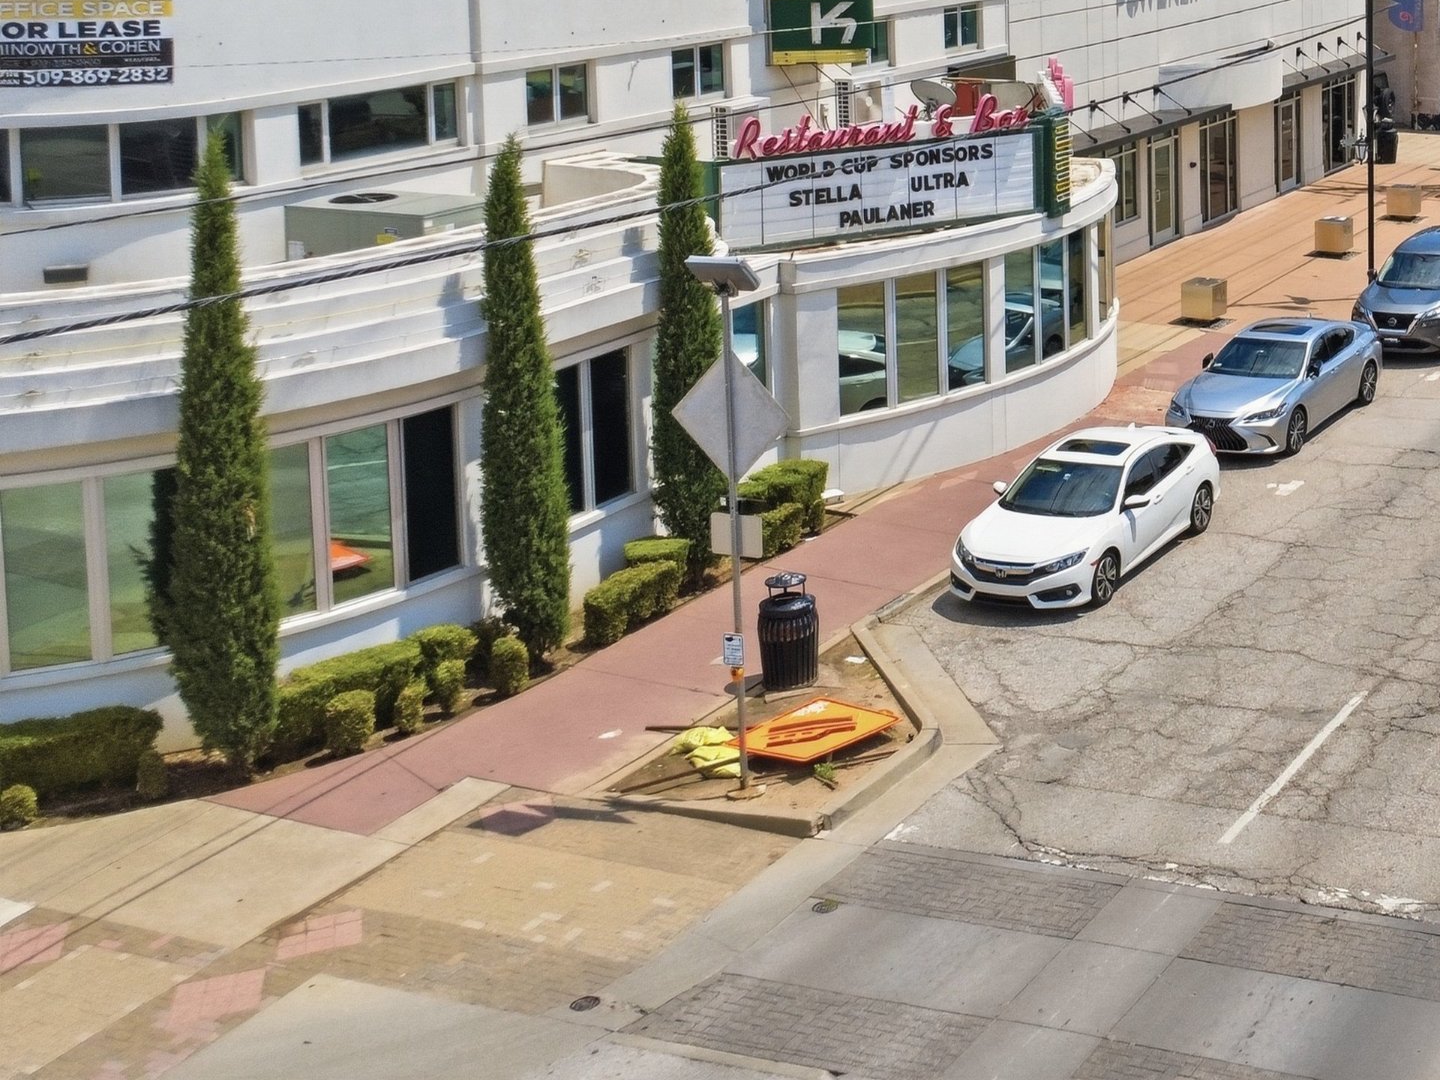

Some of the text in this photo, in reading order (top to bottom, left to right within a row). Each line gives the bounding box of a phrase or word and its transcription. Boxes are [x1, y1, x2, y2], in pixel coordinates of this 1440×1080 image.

[82, 0, 164, 16] SPACE
[58, 20, 161, 38] LEASE
[0, 43, 80, 56] INOWTH
[99, 40, 161, 54] COHEN
[23, 67, 169, 85] 509-869-2832
[732, 93, 1030, 160] Restaurant & Bar
[766, 143, 994, 183] WORLD CUP SPONSORS
[788, 171, 970, 208] STELLA ULTRA
[839, 199, 936, 229] PAULANER
